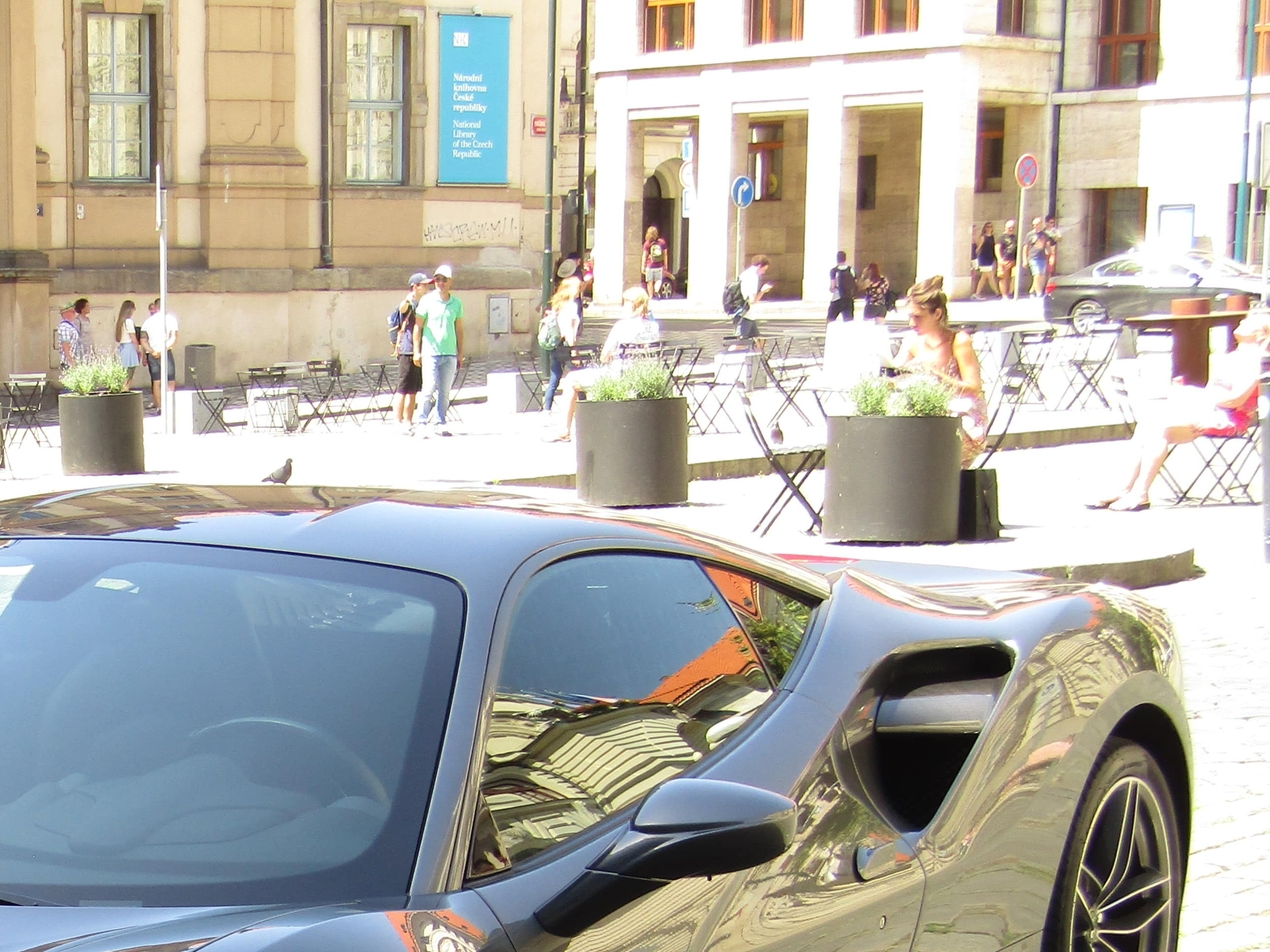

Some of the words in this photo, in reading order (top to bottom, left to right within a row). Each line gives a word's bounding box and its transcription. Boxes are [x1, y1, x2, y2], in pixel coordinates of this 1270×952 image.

[453, 73, 483, 83] Národní
[453, 83, 488, 93] knihovna
[452, 91, 475, 102] České
[453, 103, 488, 114] republiky
[452, 119, 482, 129] National
[452, 129, 477, 140] Library
[452, 140, 460, 149] of
[460, 140, 472, 149] the
[472, 140, 493, 149] Czech
[452, 149, 482, 160] Republic
